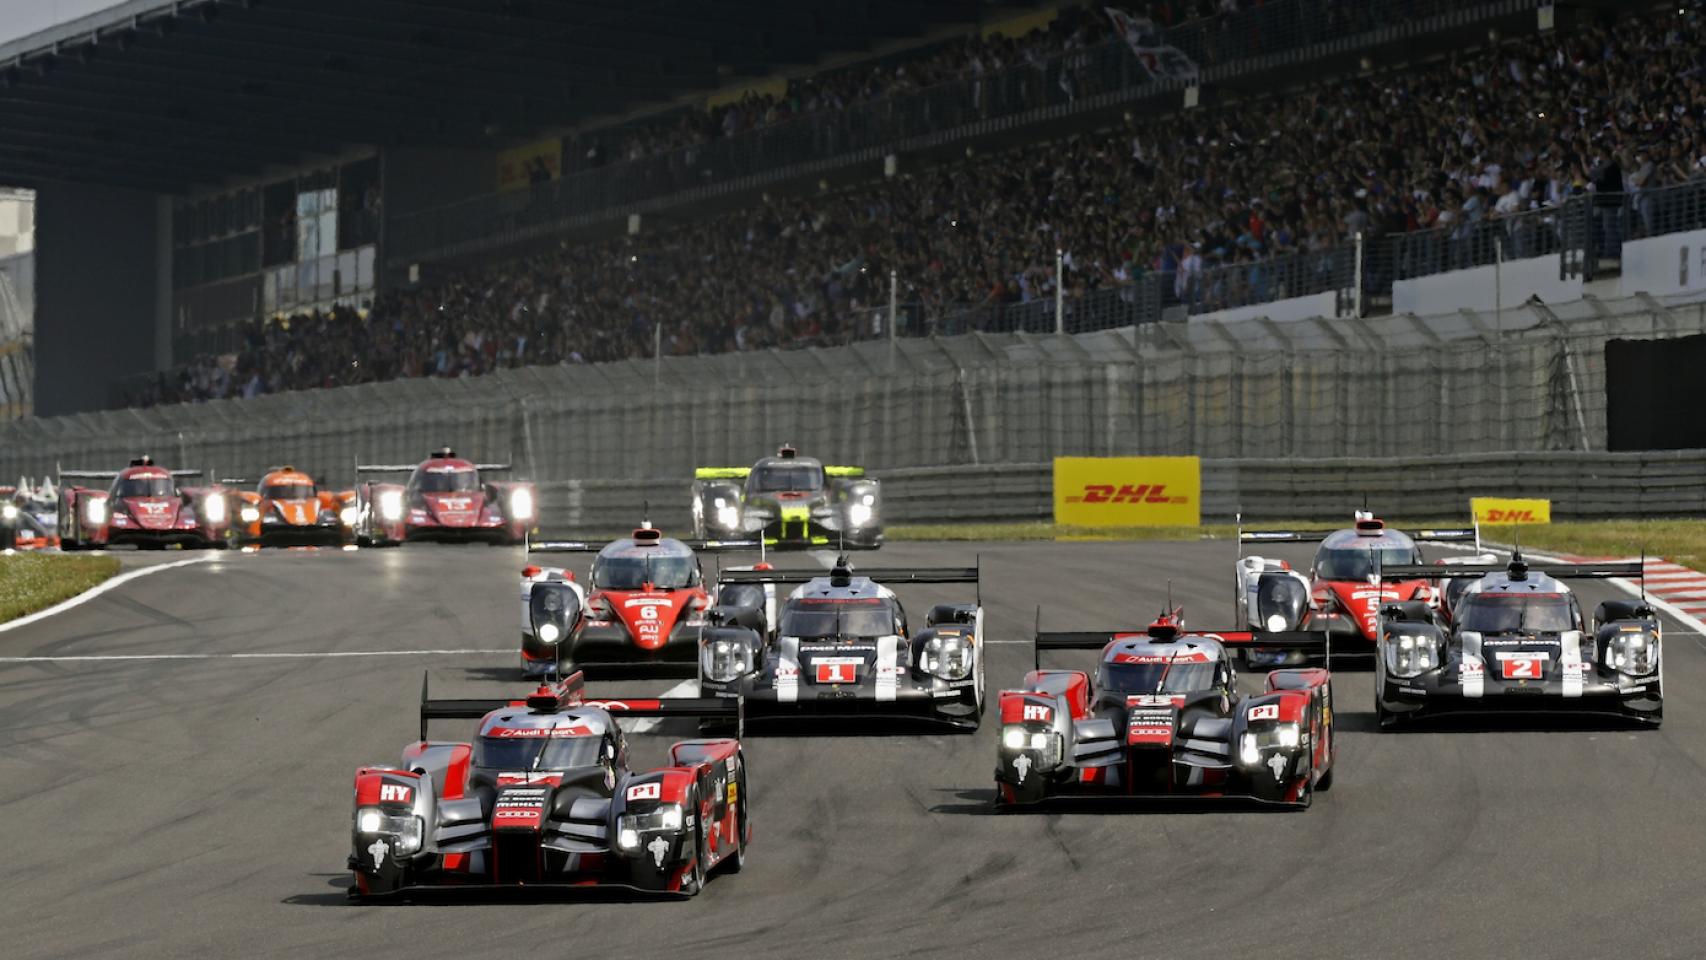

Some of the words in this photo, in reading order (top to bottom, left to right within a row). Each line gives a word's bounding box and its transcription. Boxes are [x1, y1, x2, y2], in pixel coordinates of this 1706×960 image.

[1082, 485, 1171, 503] DHL
[1486, 509, 1535, 522] DHL
[640, 606, 658, 619] 6
[828, 666, 844, 681] 1
[1511, 660, 1533, 676] 2
[1024, 705, 1050, 720] HY
[1253, 707, 1274, 717] P1
[513, 728, 540, 737] Audi
[543, 728, 576, 738] Sport
[380, 784, 411, 802] HY
[632, 785, 656, 799] P1
